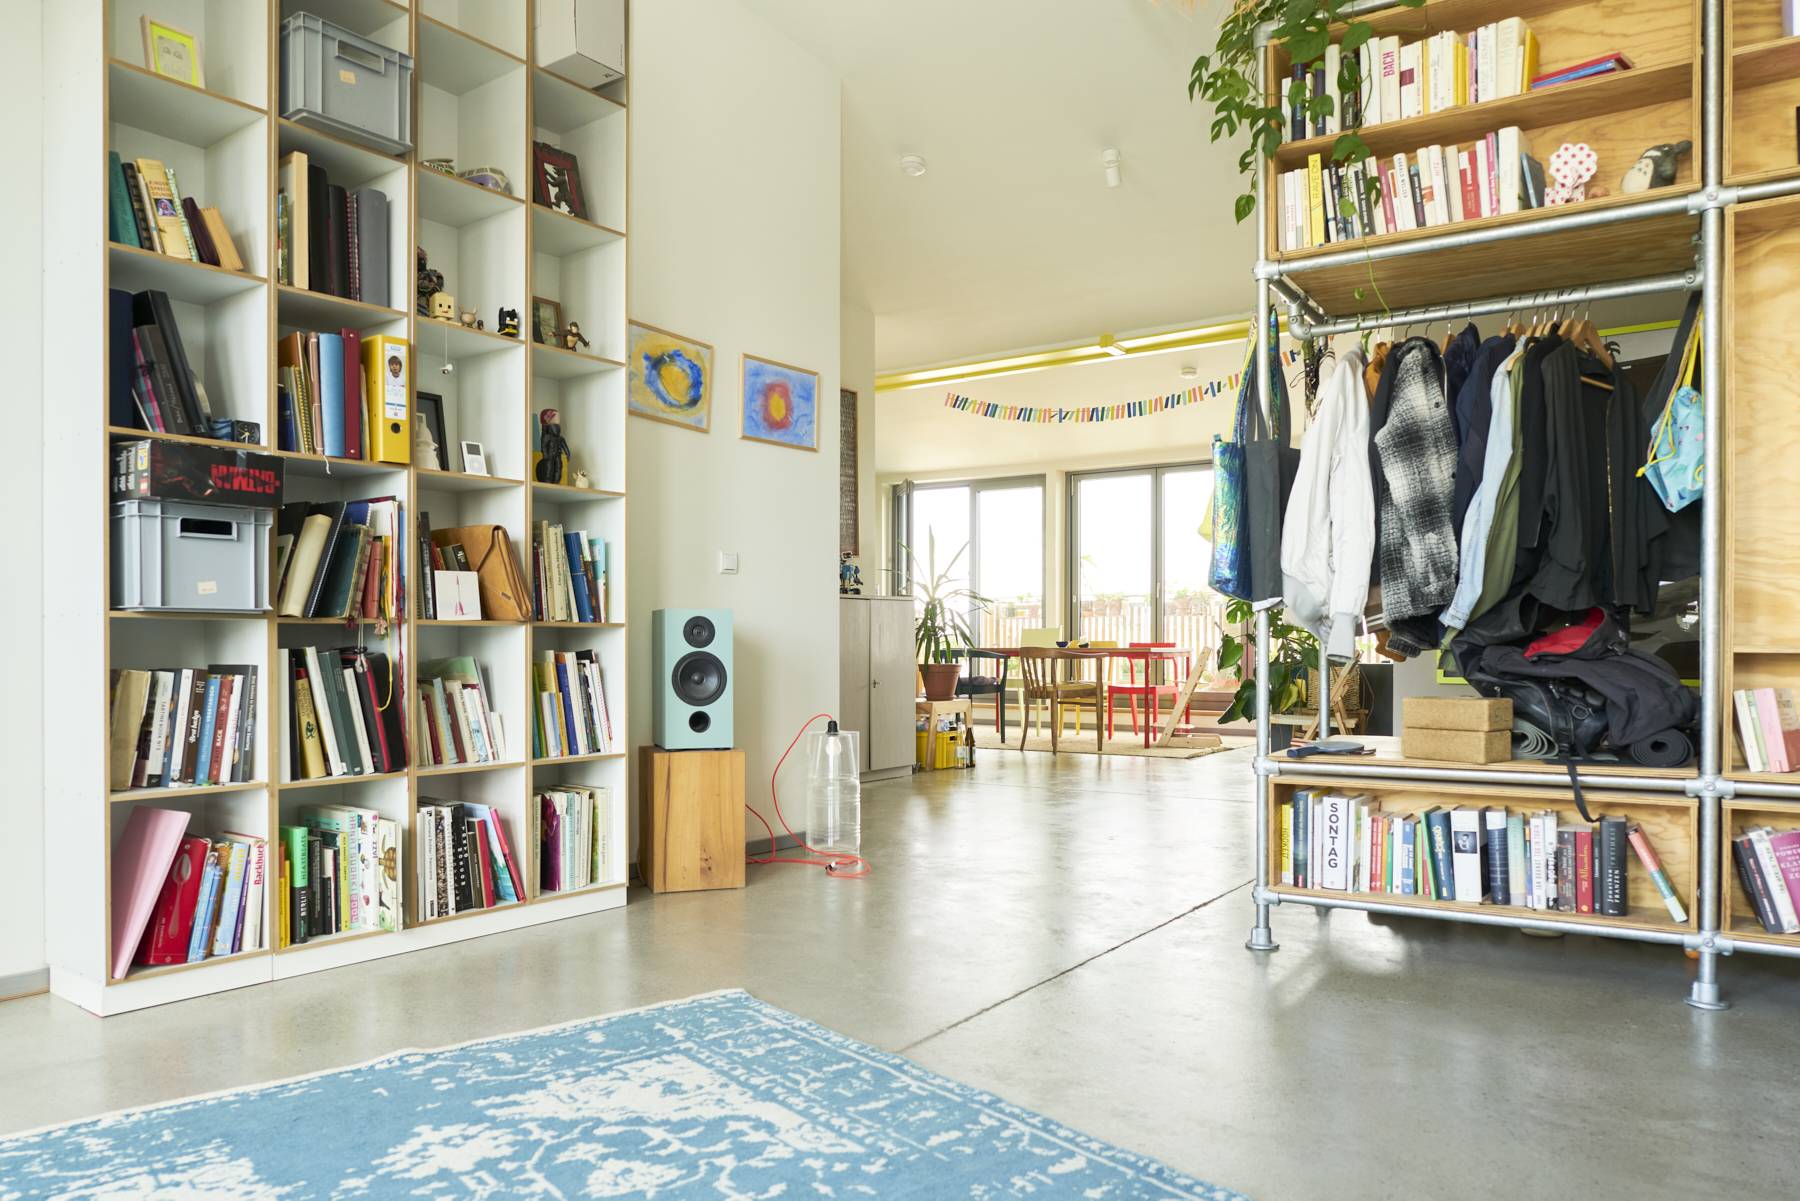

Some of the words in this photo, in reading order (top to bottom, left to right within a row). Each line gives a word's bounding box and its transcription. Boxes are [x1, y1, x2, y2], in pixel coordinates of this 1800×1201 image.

[1382, 51, 1395, 77] BACH
[1310, 159, 1319, 172] ON
[1311, 173, 1320, 199] RAVE
[205, 685, 215, 722] VEGETARISCH
[1328, 802, 1339, 868] SONTAG
[253, 844, 265, 886] Backbuch
